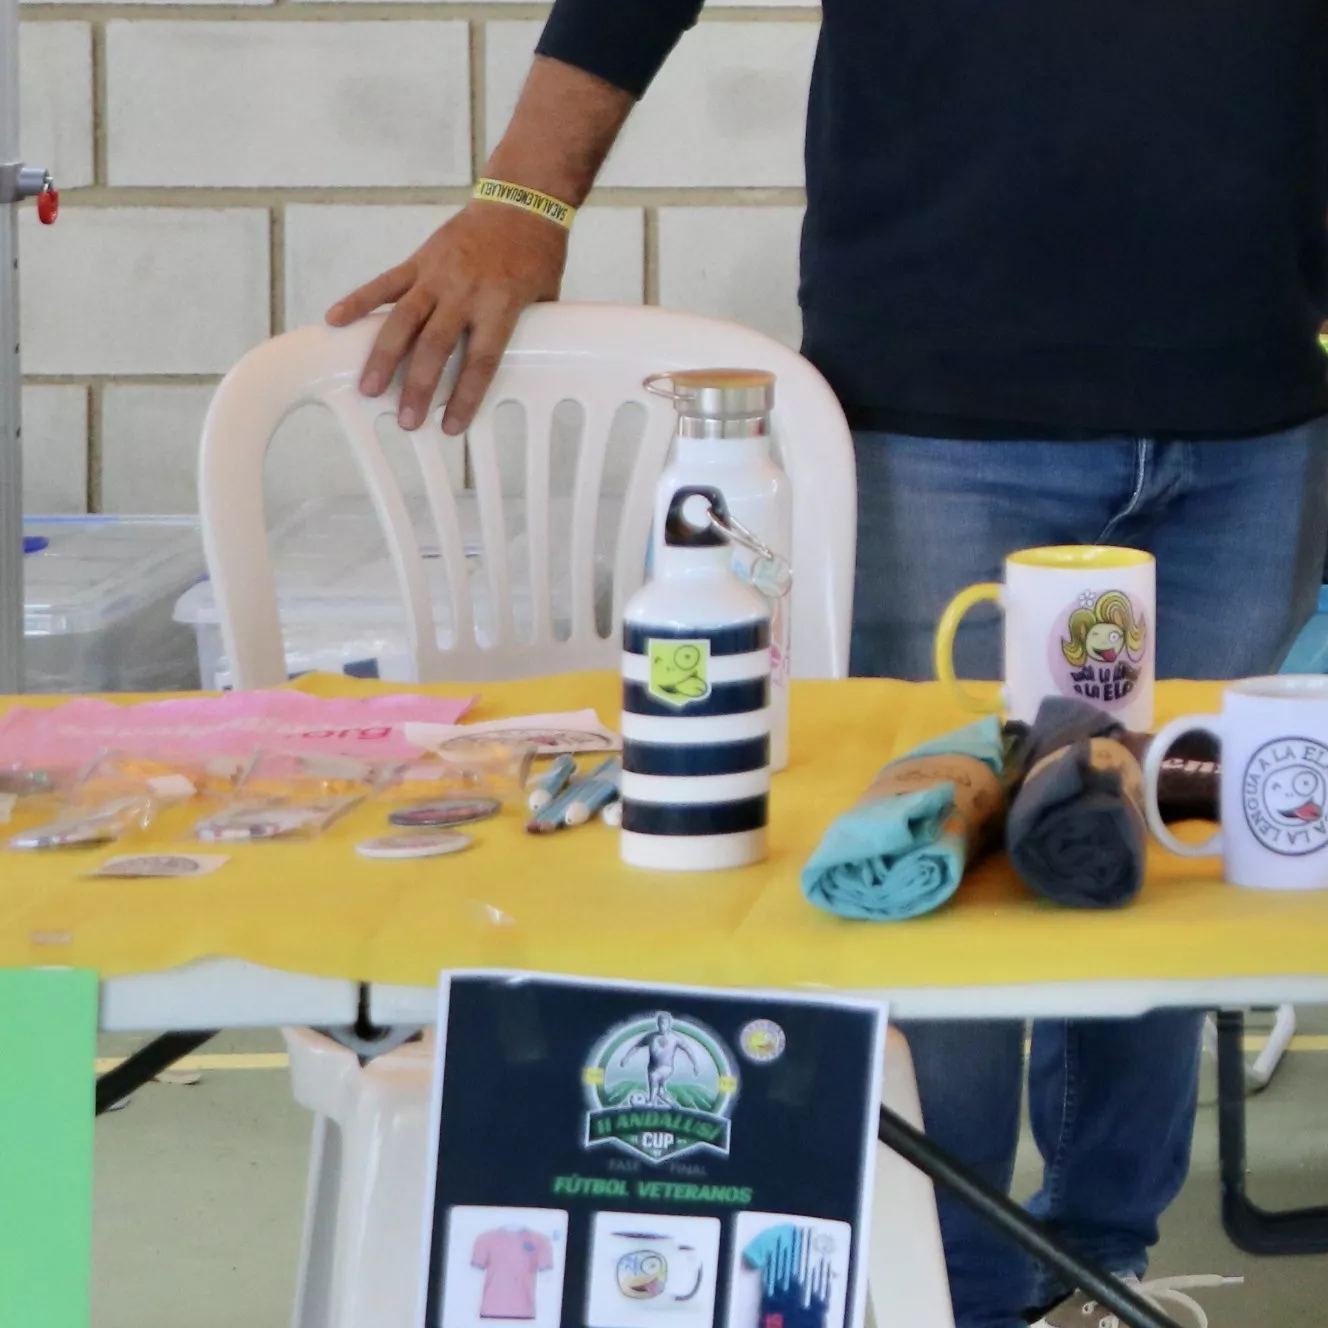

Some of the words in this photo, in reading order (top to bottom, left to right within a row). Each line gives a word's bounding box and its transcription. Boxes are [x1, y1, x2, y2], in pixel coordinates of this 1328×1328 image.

[1272, 745, 1296, 762] LA
[1258, 758, 1271, 772] A
[1246, 773, 1281, 842] LENGUA
[1287, 829, 1311, 845] LA
[642, 1132, 675, 1149] CUP
[553, 1173, 630, 1197] FÚTBOL
[637, 1179, 753, 1205] VETERANOS
